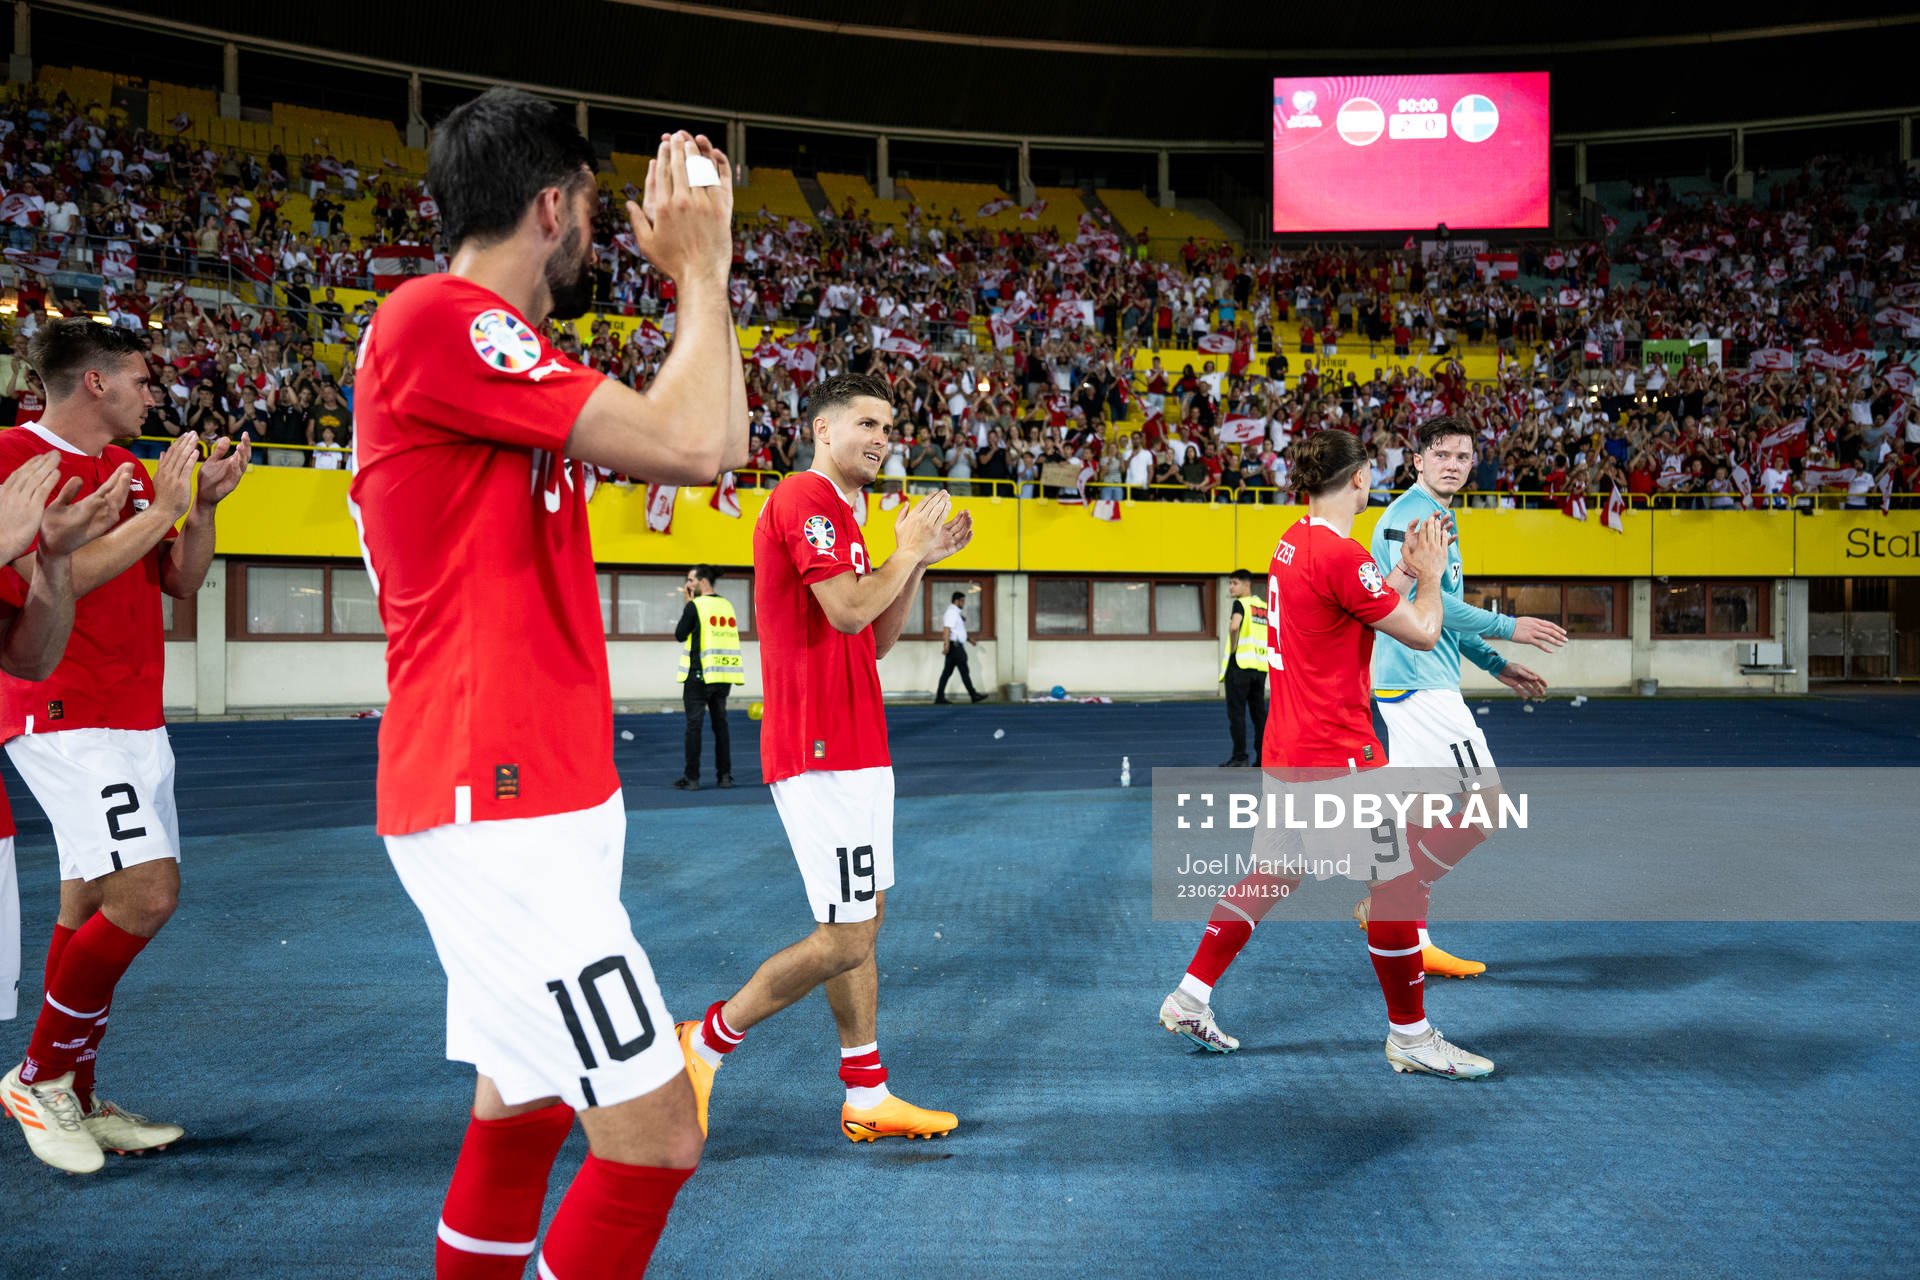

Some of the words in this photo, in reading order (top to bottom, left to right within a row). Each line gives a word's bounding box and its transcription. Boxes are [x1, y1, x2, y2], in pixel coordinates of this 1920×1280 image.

[1450, 739, 1482, 779] 11
[101, 782, 146, 841] 2
[1371, 818, 1400, 863] 9
[836, 844, 875, 903] 19
[546, 955, 656, 1070] 10
